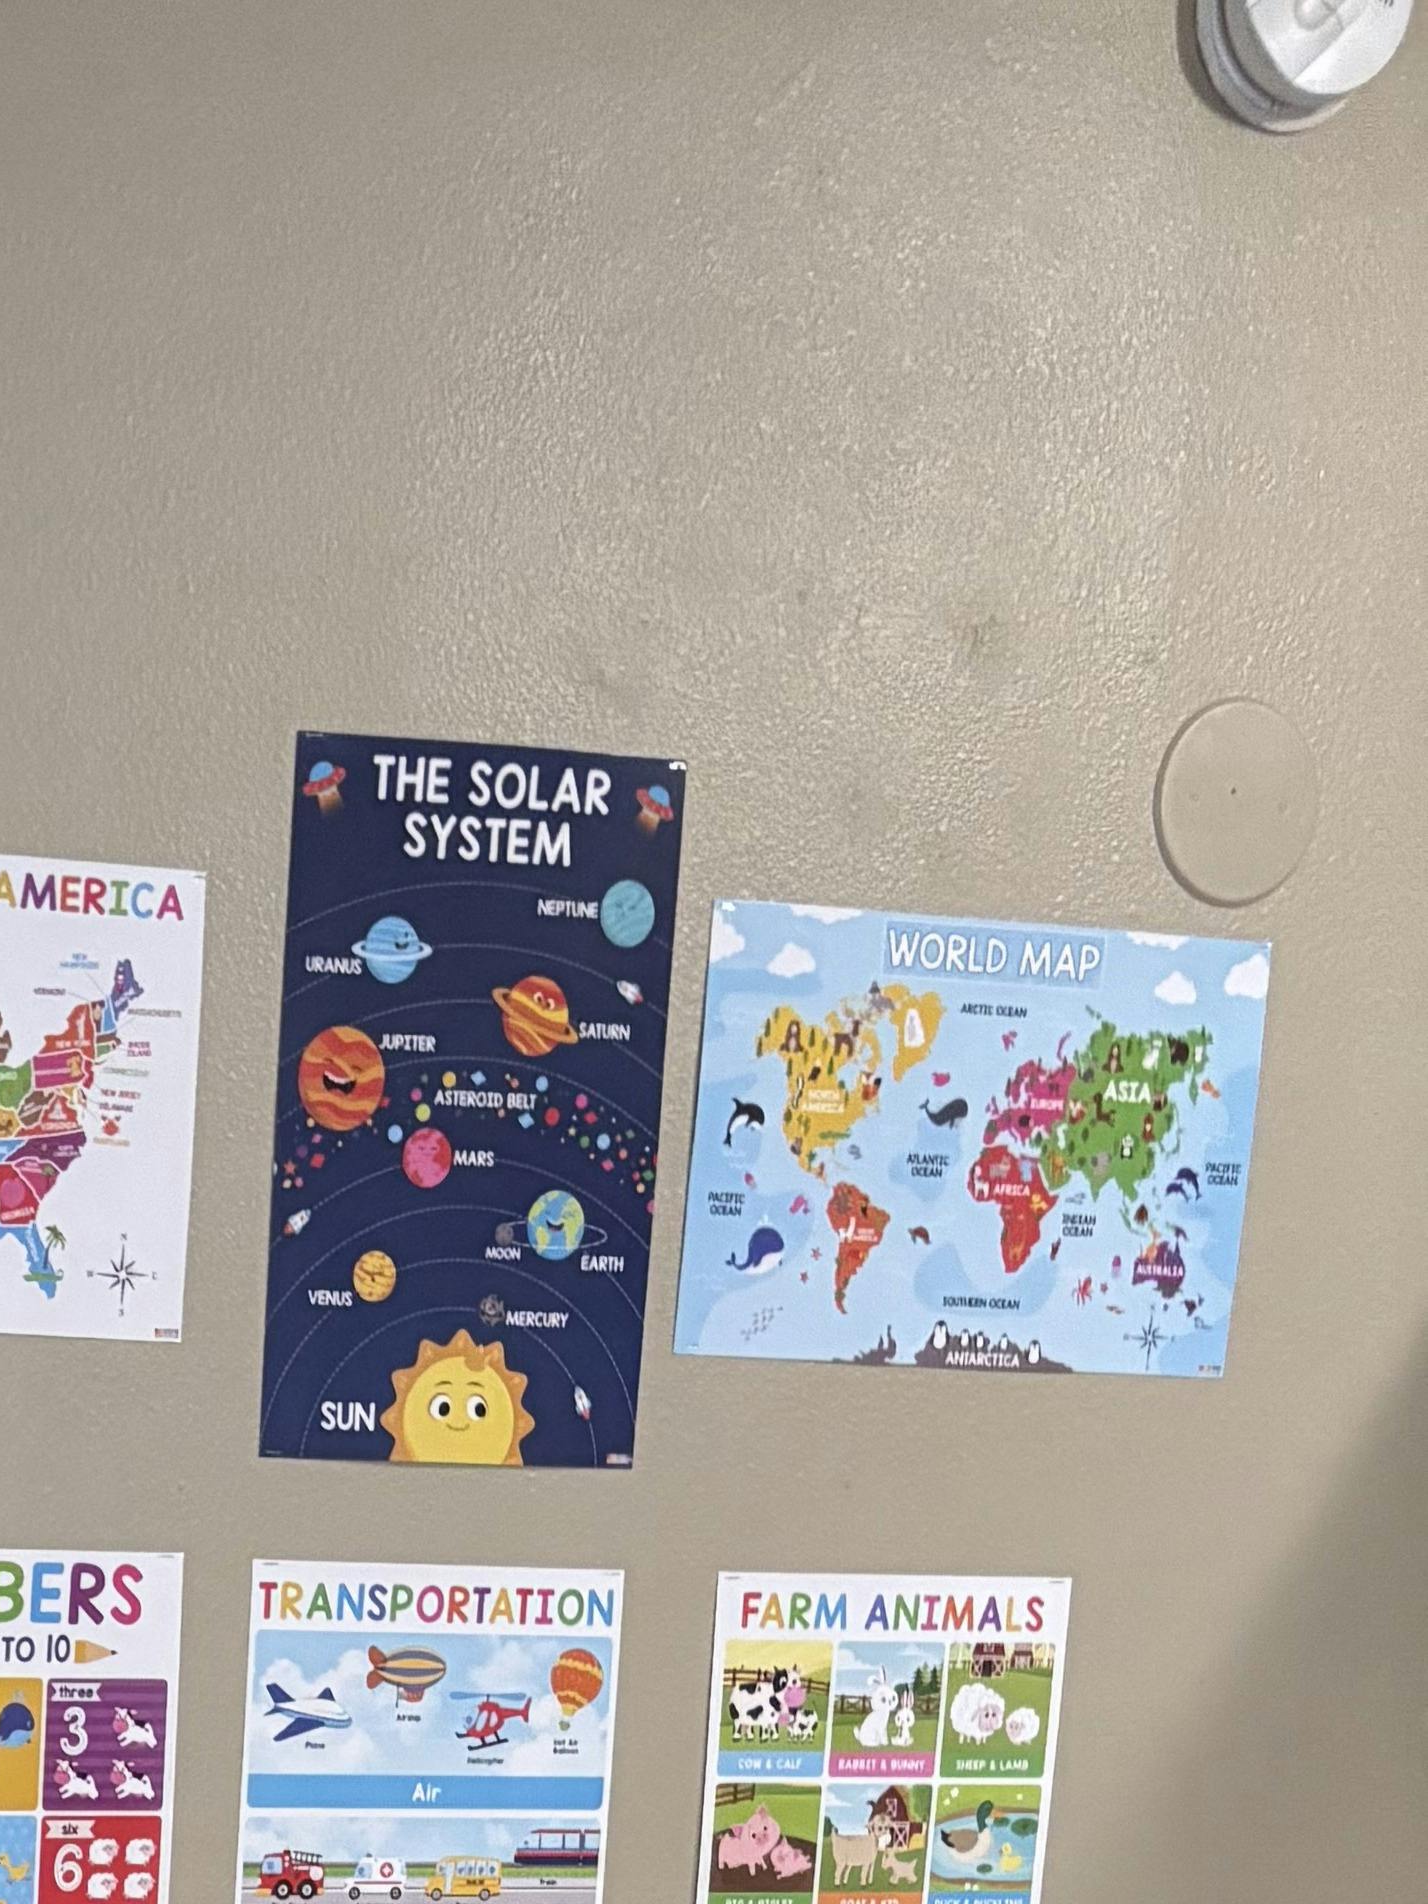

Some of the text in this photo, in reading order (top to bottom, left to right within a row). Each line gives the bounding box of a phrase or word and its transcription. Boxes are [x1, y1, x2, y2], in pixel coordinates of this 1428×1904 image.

[373, 754, 611, 816] THE SOLAR
[403, 812, 571, 867] SYSTEM
[537, 899, 599, 919] NEPTUNE
[888, 929, 1101, 982] WORLD MAP
[305, 956, 362, 975] URANUS
[960, 1003, 1027, 1019] ARCTIC OCEAN
[578, 1022, 630, 1041] SATURN
[379, 1034, 436, 1052] JUPITER
[434, 1090, 537, 1109] ASTEROID BELT
[1103, 1080, 1152, 1105] ASIA
[1029, 1098, 1065, 1111] EUROPE
[453, 1150, 494, 1167] MARS
[907, 1154, 949, 1166] ATLANTIC
[911, 1166, 943, 1178] OCEAN
[1205, 1162, 1241, 1174] PACIFIC
[1207, 1174, 1238, 1186] OCEAN
[708, 1192, 745, 1205] PACIFIC
[993, 1183, 1030, 1197] AFRICA
[710, 1204, 742, 1216] OCEAN
[1062, 1226, 1093, 1237] OCEAN
[485, 1246, 521, 1260] MOON
[580, 1255, 624, 1272] EARTH
[1136, 1264, 1185, 1278] AUSTRALIA
[308, 1289, 353, 1306] VENUS
[989, 1297, 1020, 1310] OCEAN
[505, 1311, 568, 1329] MERCURY
[945, 1350, 1021, 1368] ANTARCTICA
[320, 1401, 376, 1432] SUN
[259, 1580, 615, 1626] TRANSPORTATION
[741, 1592, 1045, 1633] FARM ANIMALS
[2, 1636, 35, 1663] TO
[47, 1634, 70, 1663] 10
[58, 1685, 93, 1698] three
[60, 1706, 89, 1756] 3
[738, 1759, 802, 1770] COW & CALF
[838, 1759, 926, 1772] RABBIT & BUNNY
[956, 1759, 1029, 1771] SHEEP & LAMB
[411, 1783, 442, 1802] Air
[60, 1822, 79, 1836] six
[54, 1843, 83, 1892] 6
